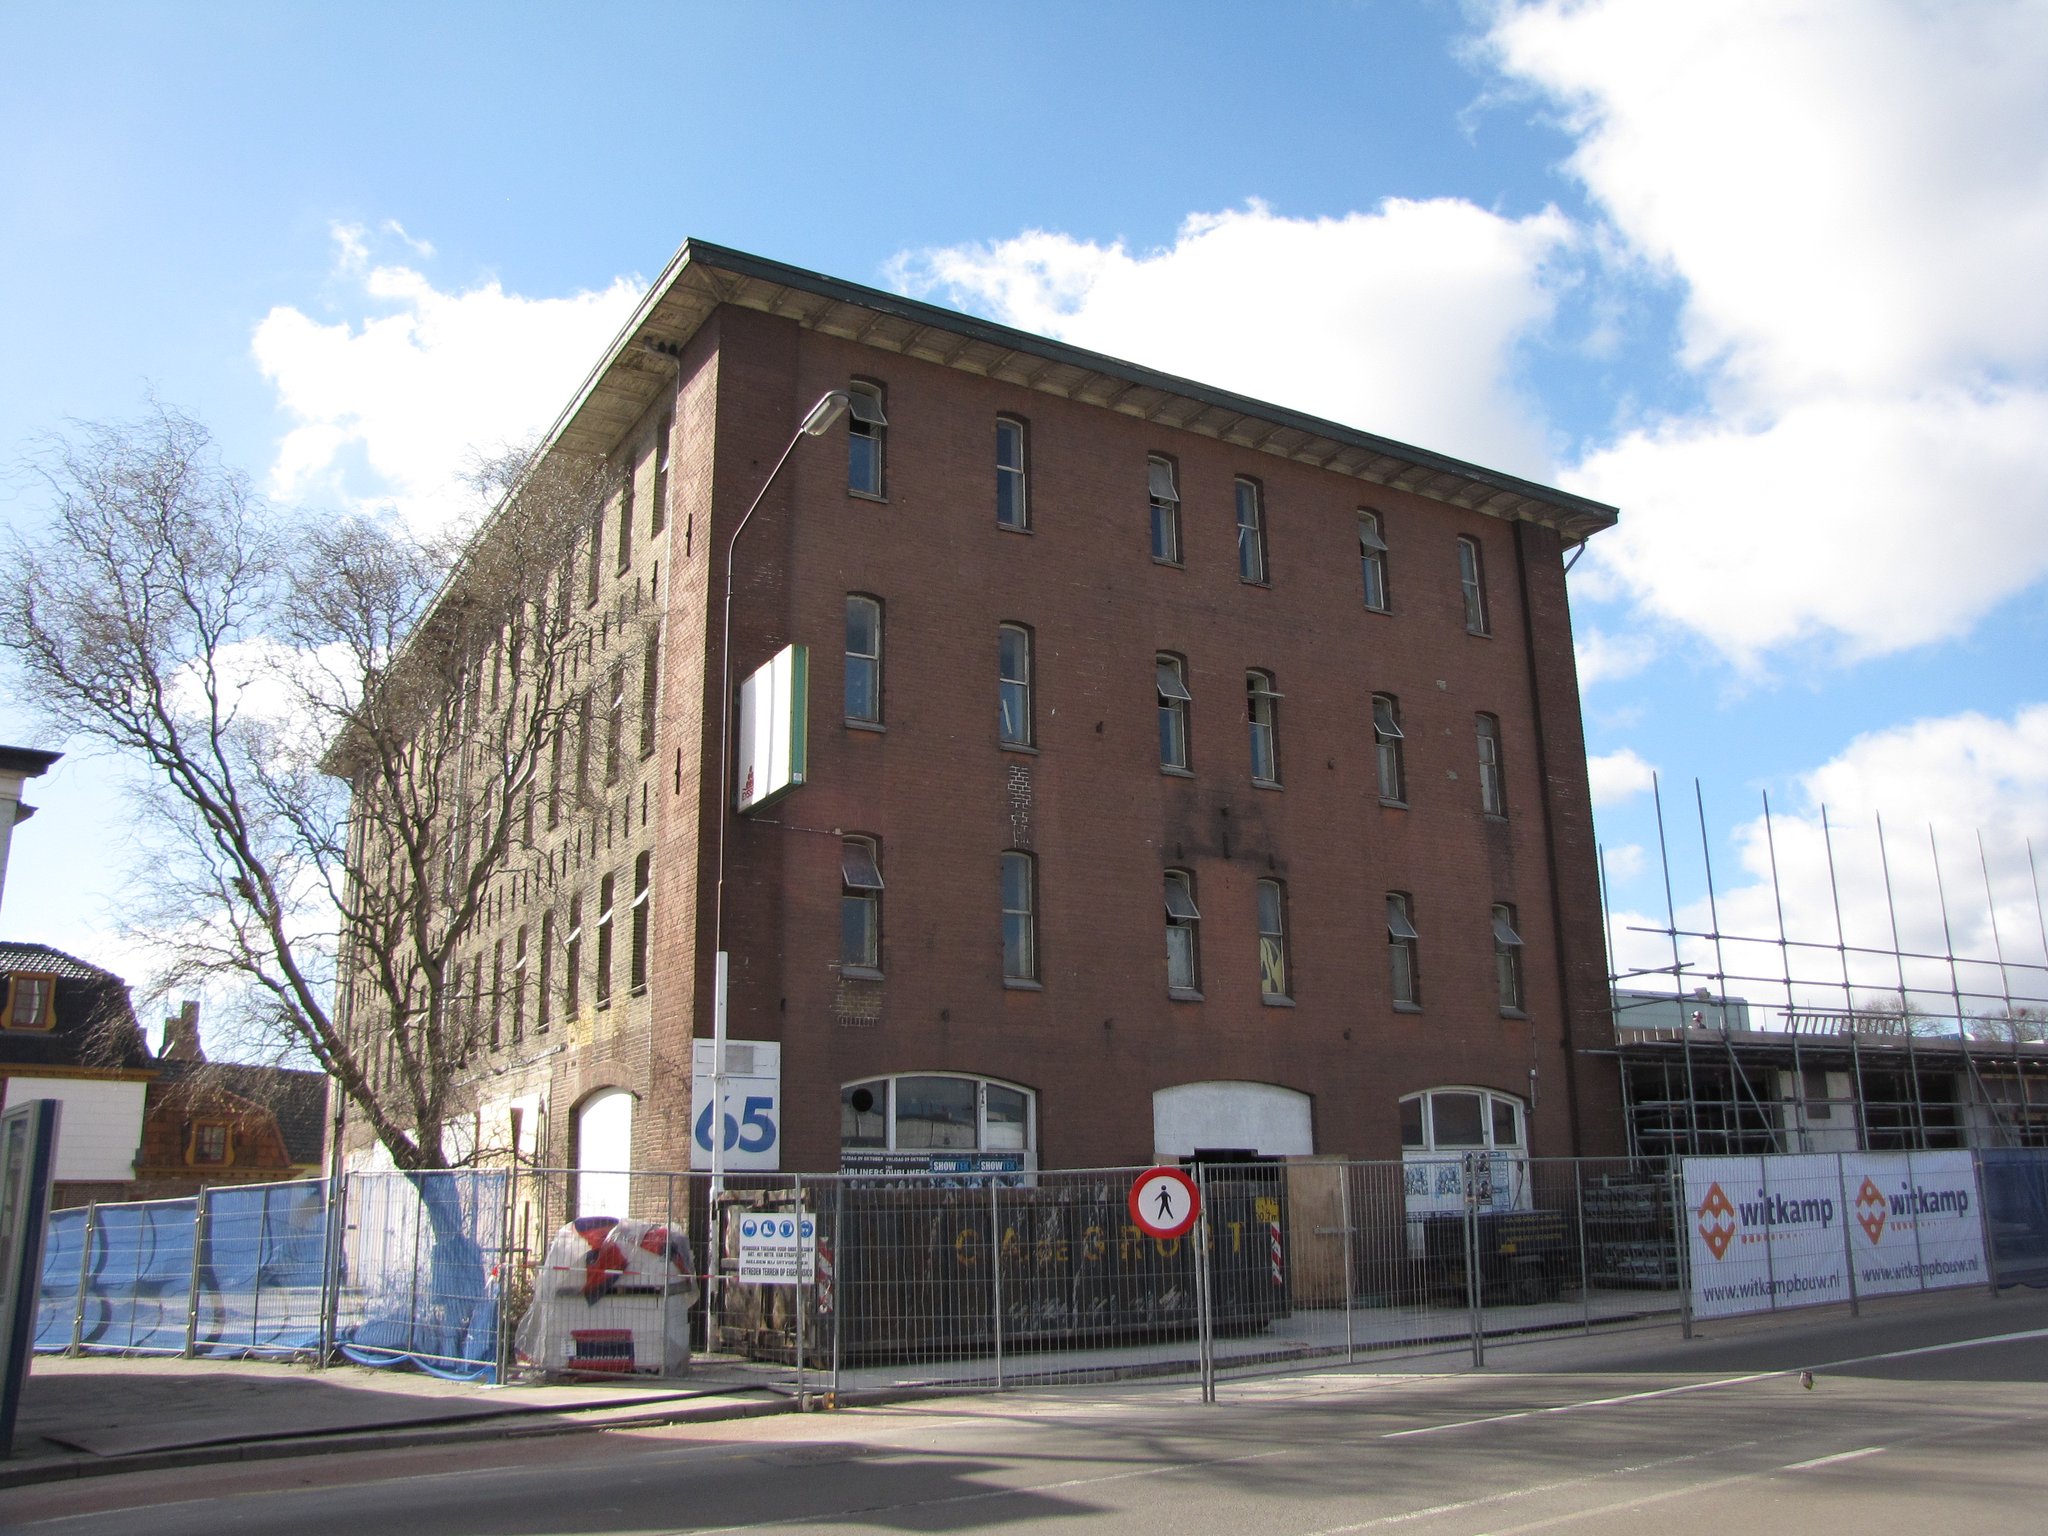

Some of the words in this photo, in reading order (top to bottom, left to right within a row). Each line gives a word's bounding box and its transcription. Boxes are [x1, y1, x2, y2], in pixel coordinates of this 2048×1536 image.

[695, 1096, 776, 1153] 65
[1739, 1188, 1833, 1228] witkamp
[1888, 1181, 1969, 1218] witkamp
[1703, 1270, 1840, 1302] www.witkampbouw.nl
[1862, 1254, 1978, 1282] www.witkampbouw.nl
